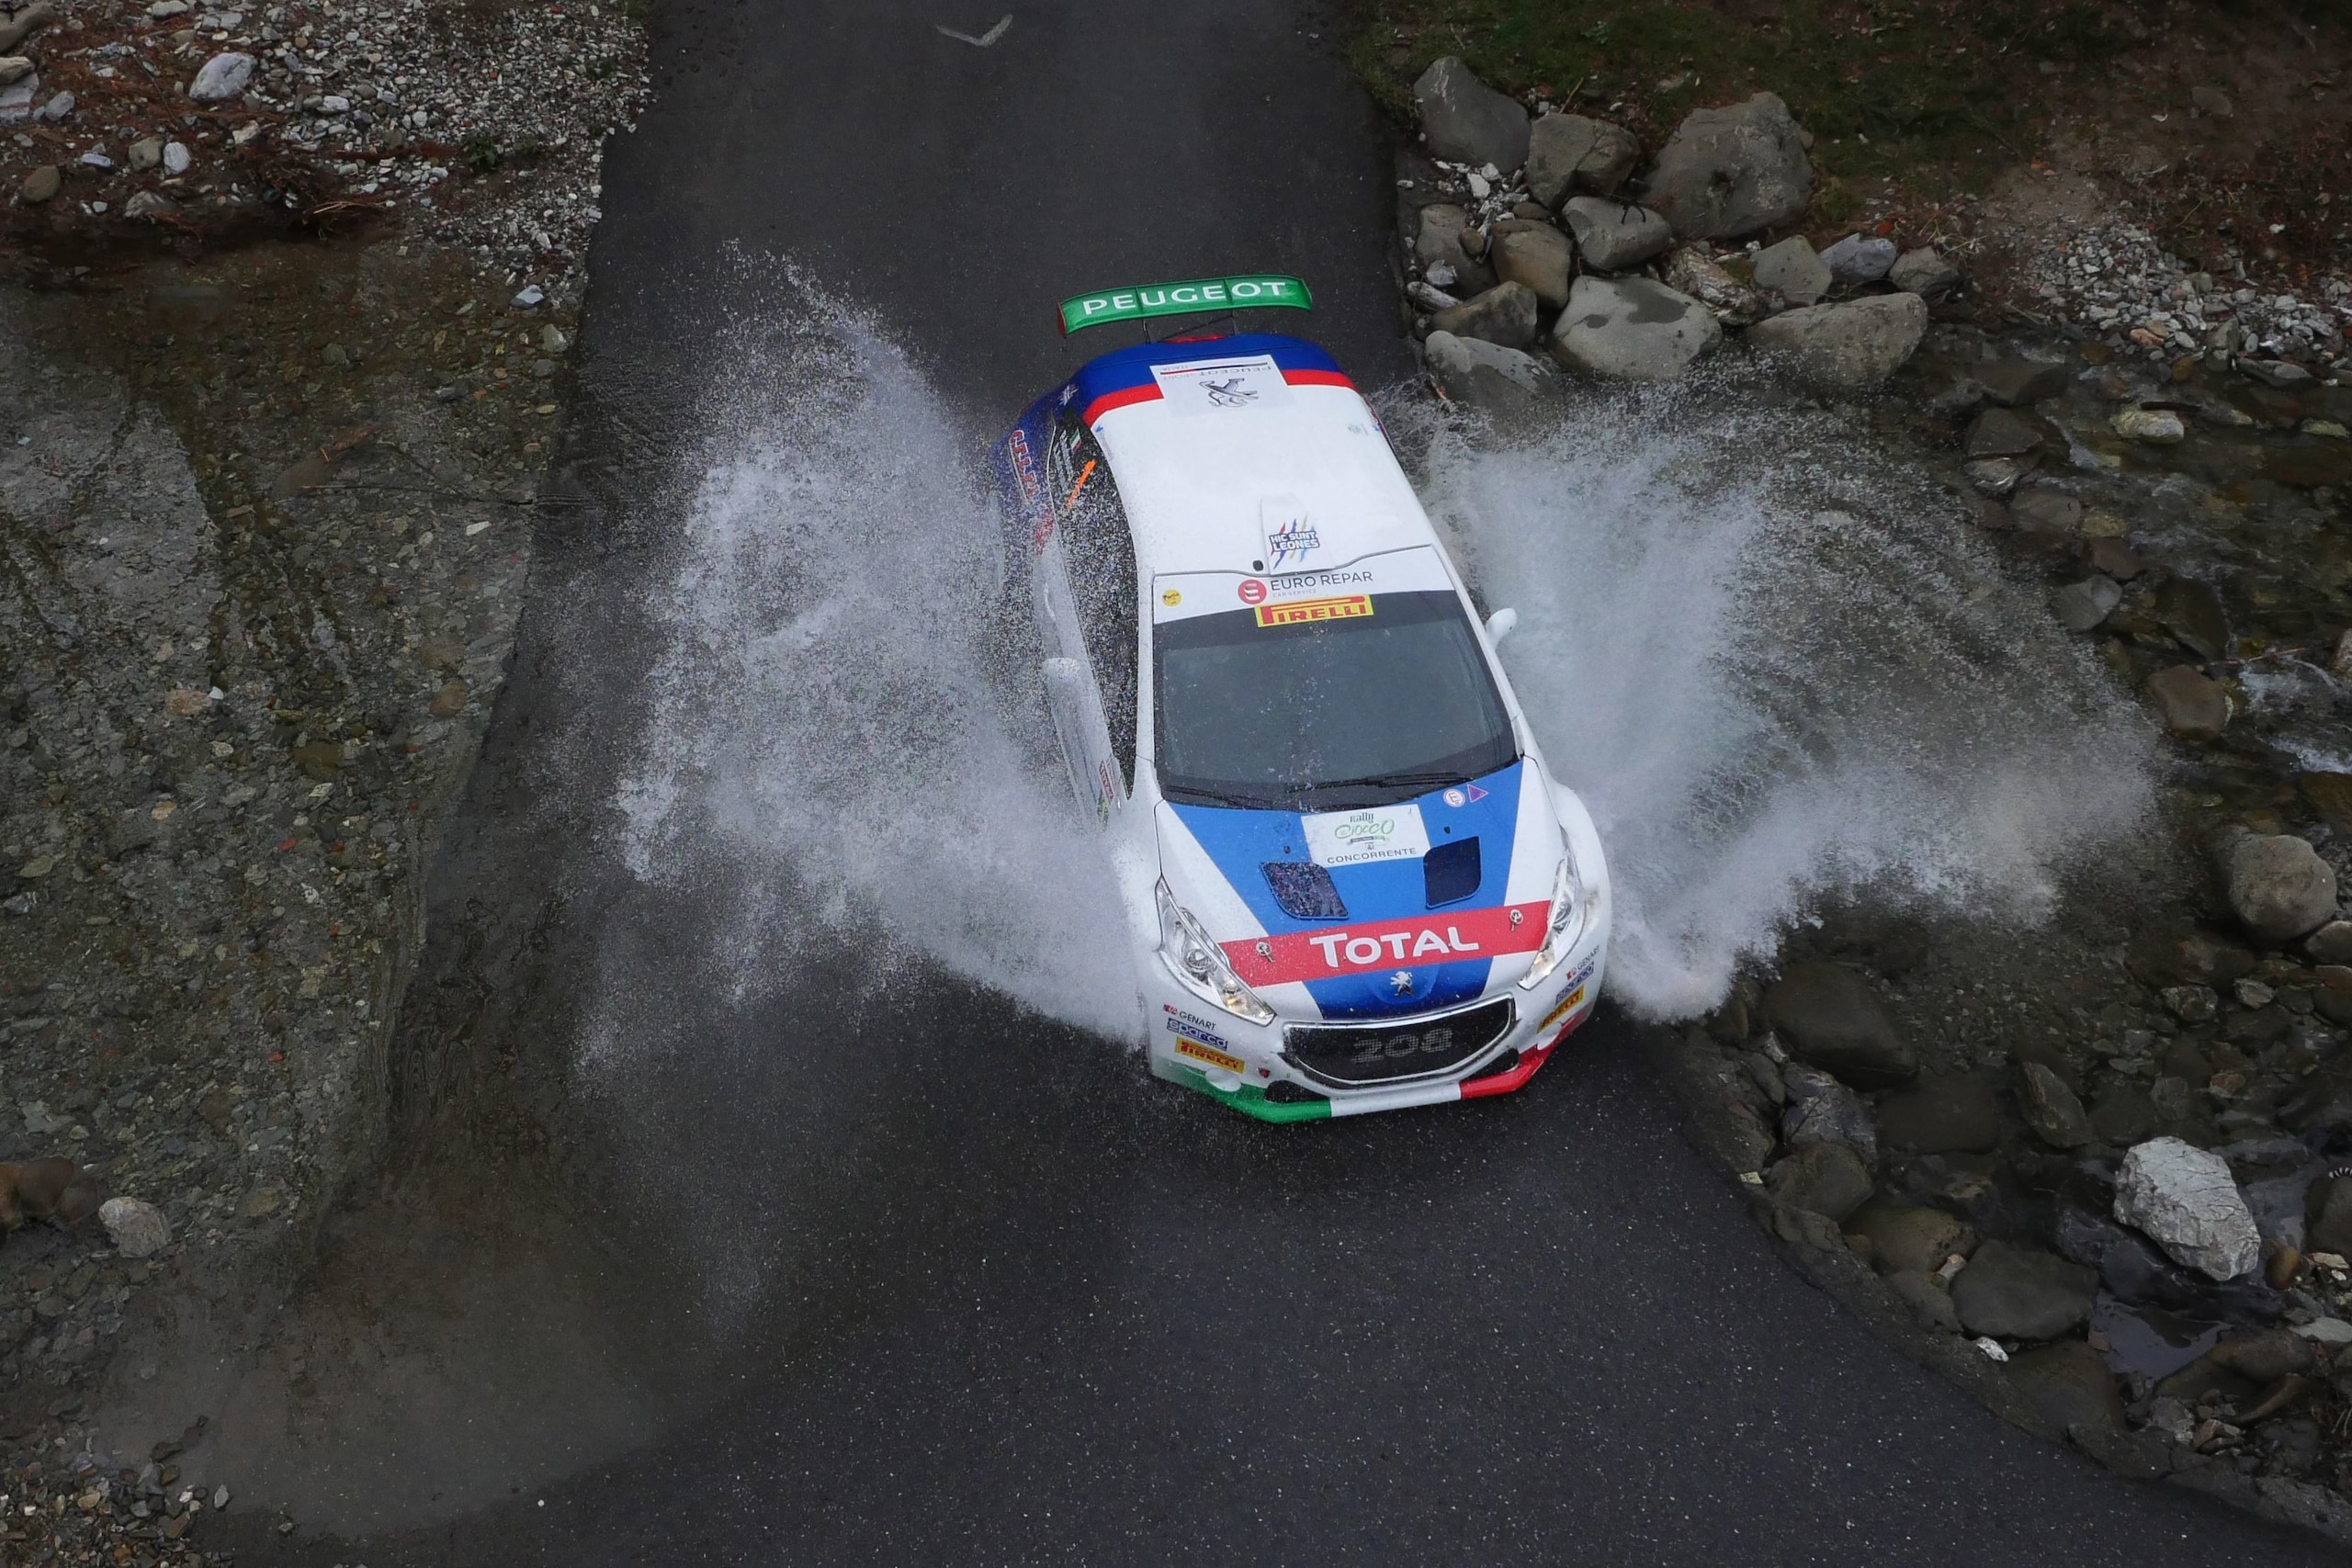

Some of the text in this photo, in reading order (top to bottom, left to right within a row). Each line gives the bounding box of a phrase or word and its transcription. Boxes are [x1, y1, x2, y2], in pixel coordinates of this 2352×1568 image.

[1082, 281, 1286, 315] PEUGEOT
[1270, 531, 1316, 543] HIC SUNT
[1272, 538, 1319, 551] LEONES
[1270, 571, 1374, 591] EURO REPAR
[1260, 595, 1367, 625] PIRELLI
[1327, 847, 1417, 863] CONCORRENTE
[1309, 926, 1479, 968] TOTAL
[1179, 1011, 1216, 1030] GENART
[1181, 1040, 1239, 1069] PIRELLI
[1351, 1027, 1453, 1063] 208
